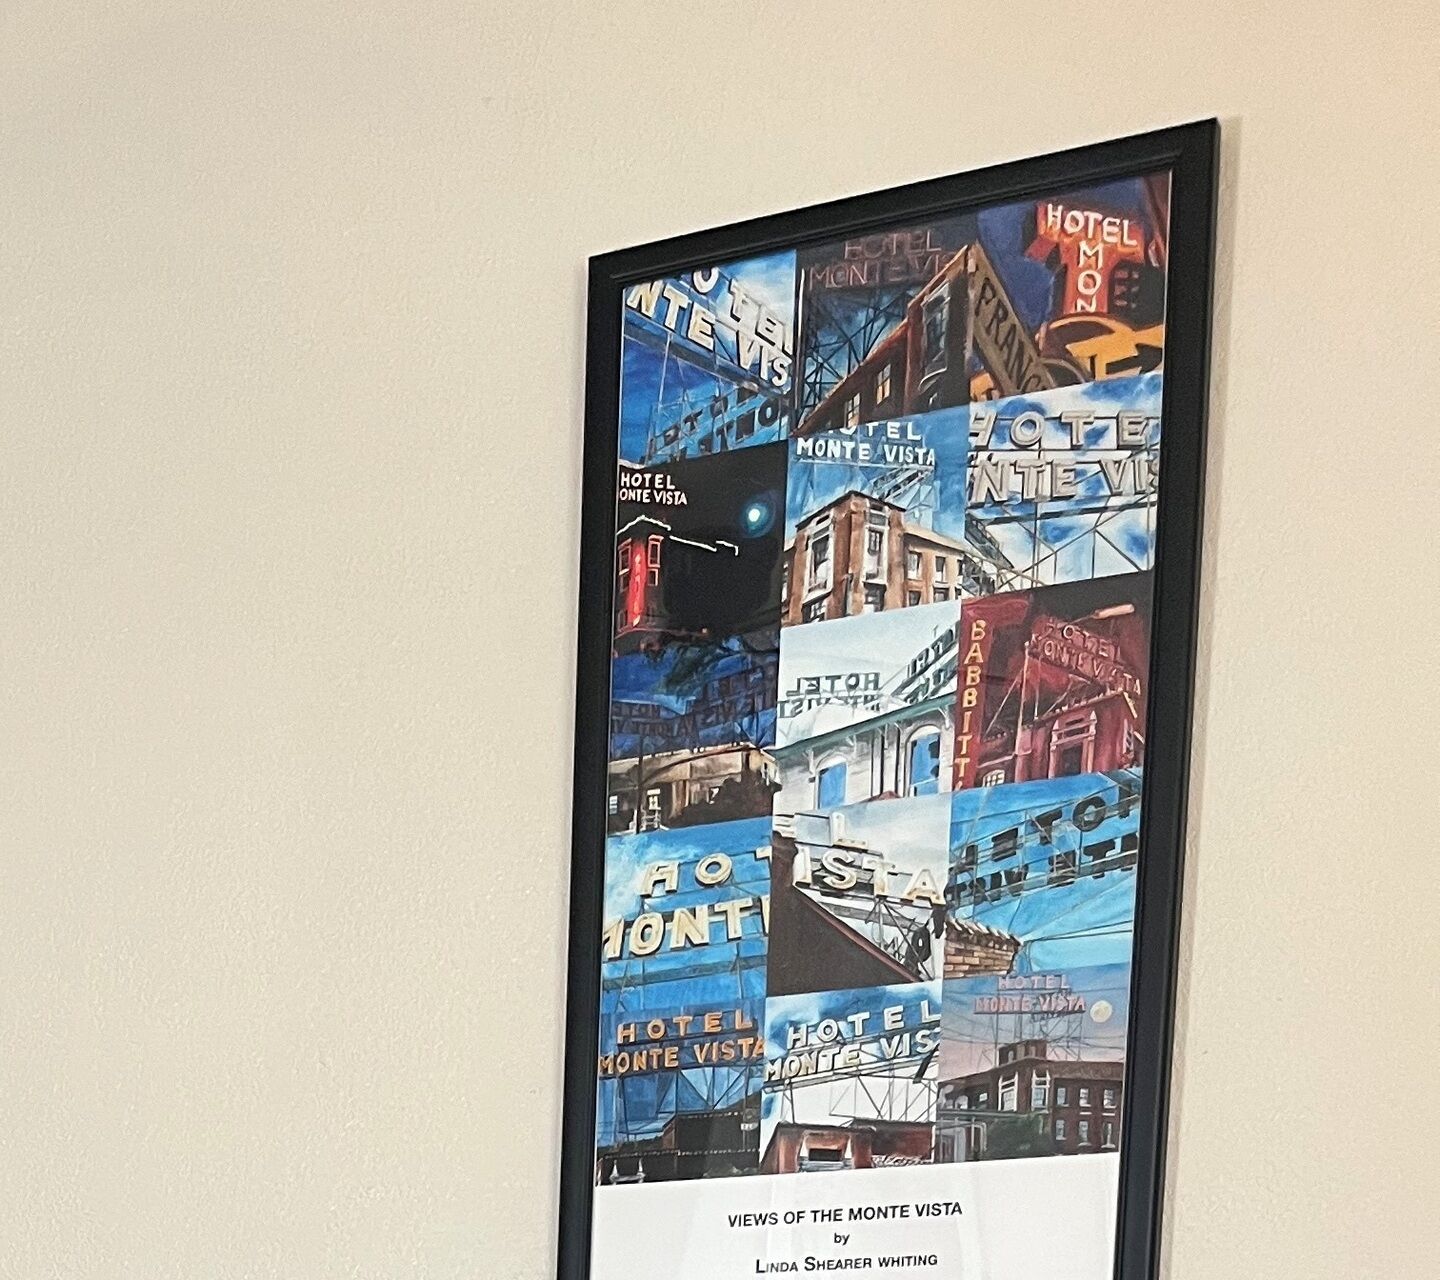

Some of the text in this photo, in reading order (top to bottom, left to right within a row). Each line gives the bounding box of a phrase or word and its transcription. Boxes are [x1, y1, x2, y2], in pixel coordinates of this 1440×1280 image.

[1047, 203, 1138, 247] HOTEL
[796, 437, 936, 466] MONTE VISTA
[620, 472, 676, 490] HOTEL
[619, 488, 688, 506] ONTE VISTA
[998, 975, 1070, 990] HOTEL
[975, 993, 1087, 1013] MONTE VISTA
[617, 1008, 754, 1044] HOTEL
[787, 999, 941, 1050] HOTEL
[599, 1045, 679, 1075] MONTE
[765, 1043, 861, 1082] MONTE
[728, 1201, 963, 1228] VIEWS OF THE MONTE VISTA
[833, 1232, 850, 1246] by
[755, 1258, 799, 1274] LINDA
[804, 1256, 873, 1272] SHEARER
